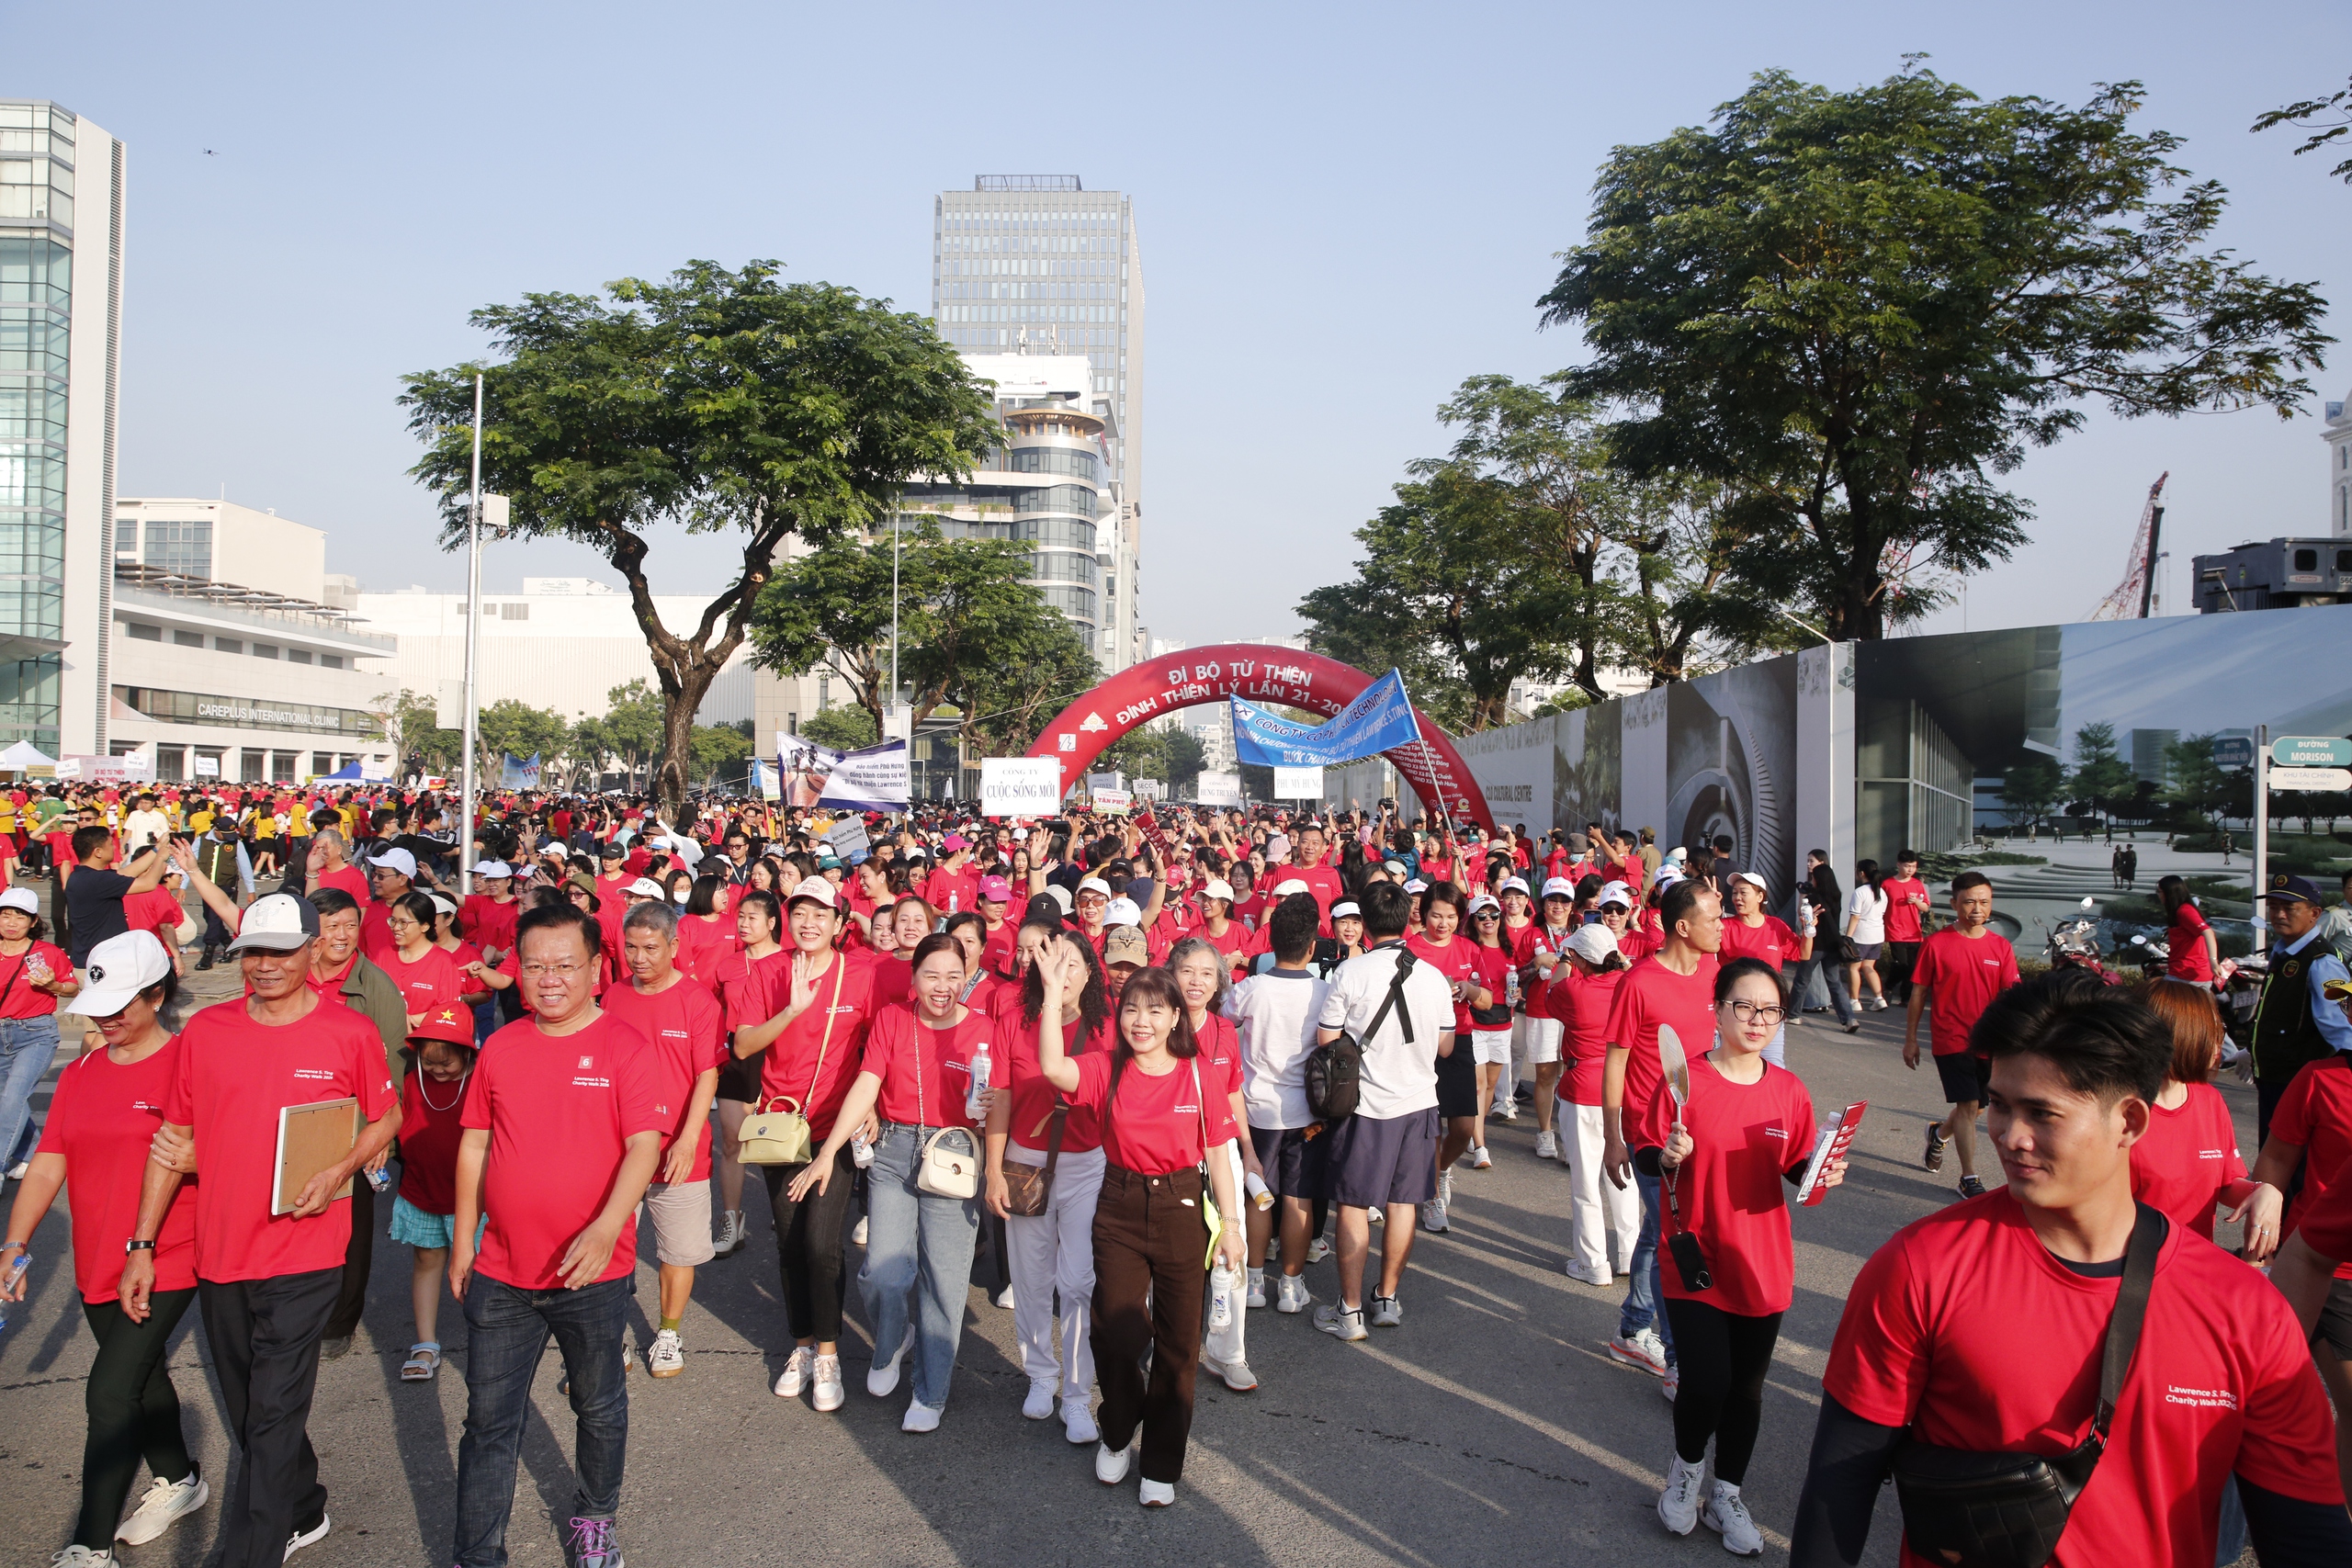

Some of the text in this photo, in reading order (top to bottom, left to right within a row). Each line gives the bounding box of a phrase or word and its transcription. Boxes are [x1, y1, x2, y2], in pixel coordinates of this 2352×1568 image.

[1169, 659, 1312, 687] ĐI BỘ TỪ THIỆN
[1161, 682, 1210, 705] THIỆN
[1219, 679, 1240, 695] LÝ
[1250, 680, 1284, 698] LẦN
[198, 704, 246, 719] CAREPLUS
[249, 708, 312, 725] INTERNATIONAL
[314, 716, 339, 728] CLINIC
[1255, 717, 1288, 736] CÔNG
[1291, 728, 1307, 739] TY
[1350, 678, 1398, 722] TECHNOLOGY
[1329, 743, 1339, 756] BỘ
[1363, 717, 1388, 741] LAWRENCE
[1283, 750, 1305, 763] BƯỚC
[1398, 750, 1417, 758] Phường
[2291, 752, 2334, 761] MORISON
[987, 778, 1055, 801] CUỘC SỐNG MỚI
[1302, 779, 1321, 788] HƯNG
[1494, 784, 1532, 802] CULTURAL CENTRE
[582, 1058, 589, 1066] 6
[2165, 1394, 2237, 1410] Charity Walk 2026
[2168, 1384, 2236, 1402] Lawrence S. Ting
